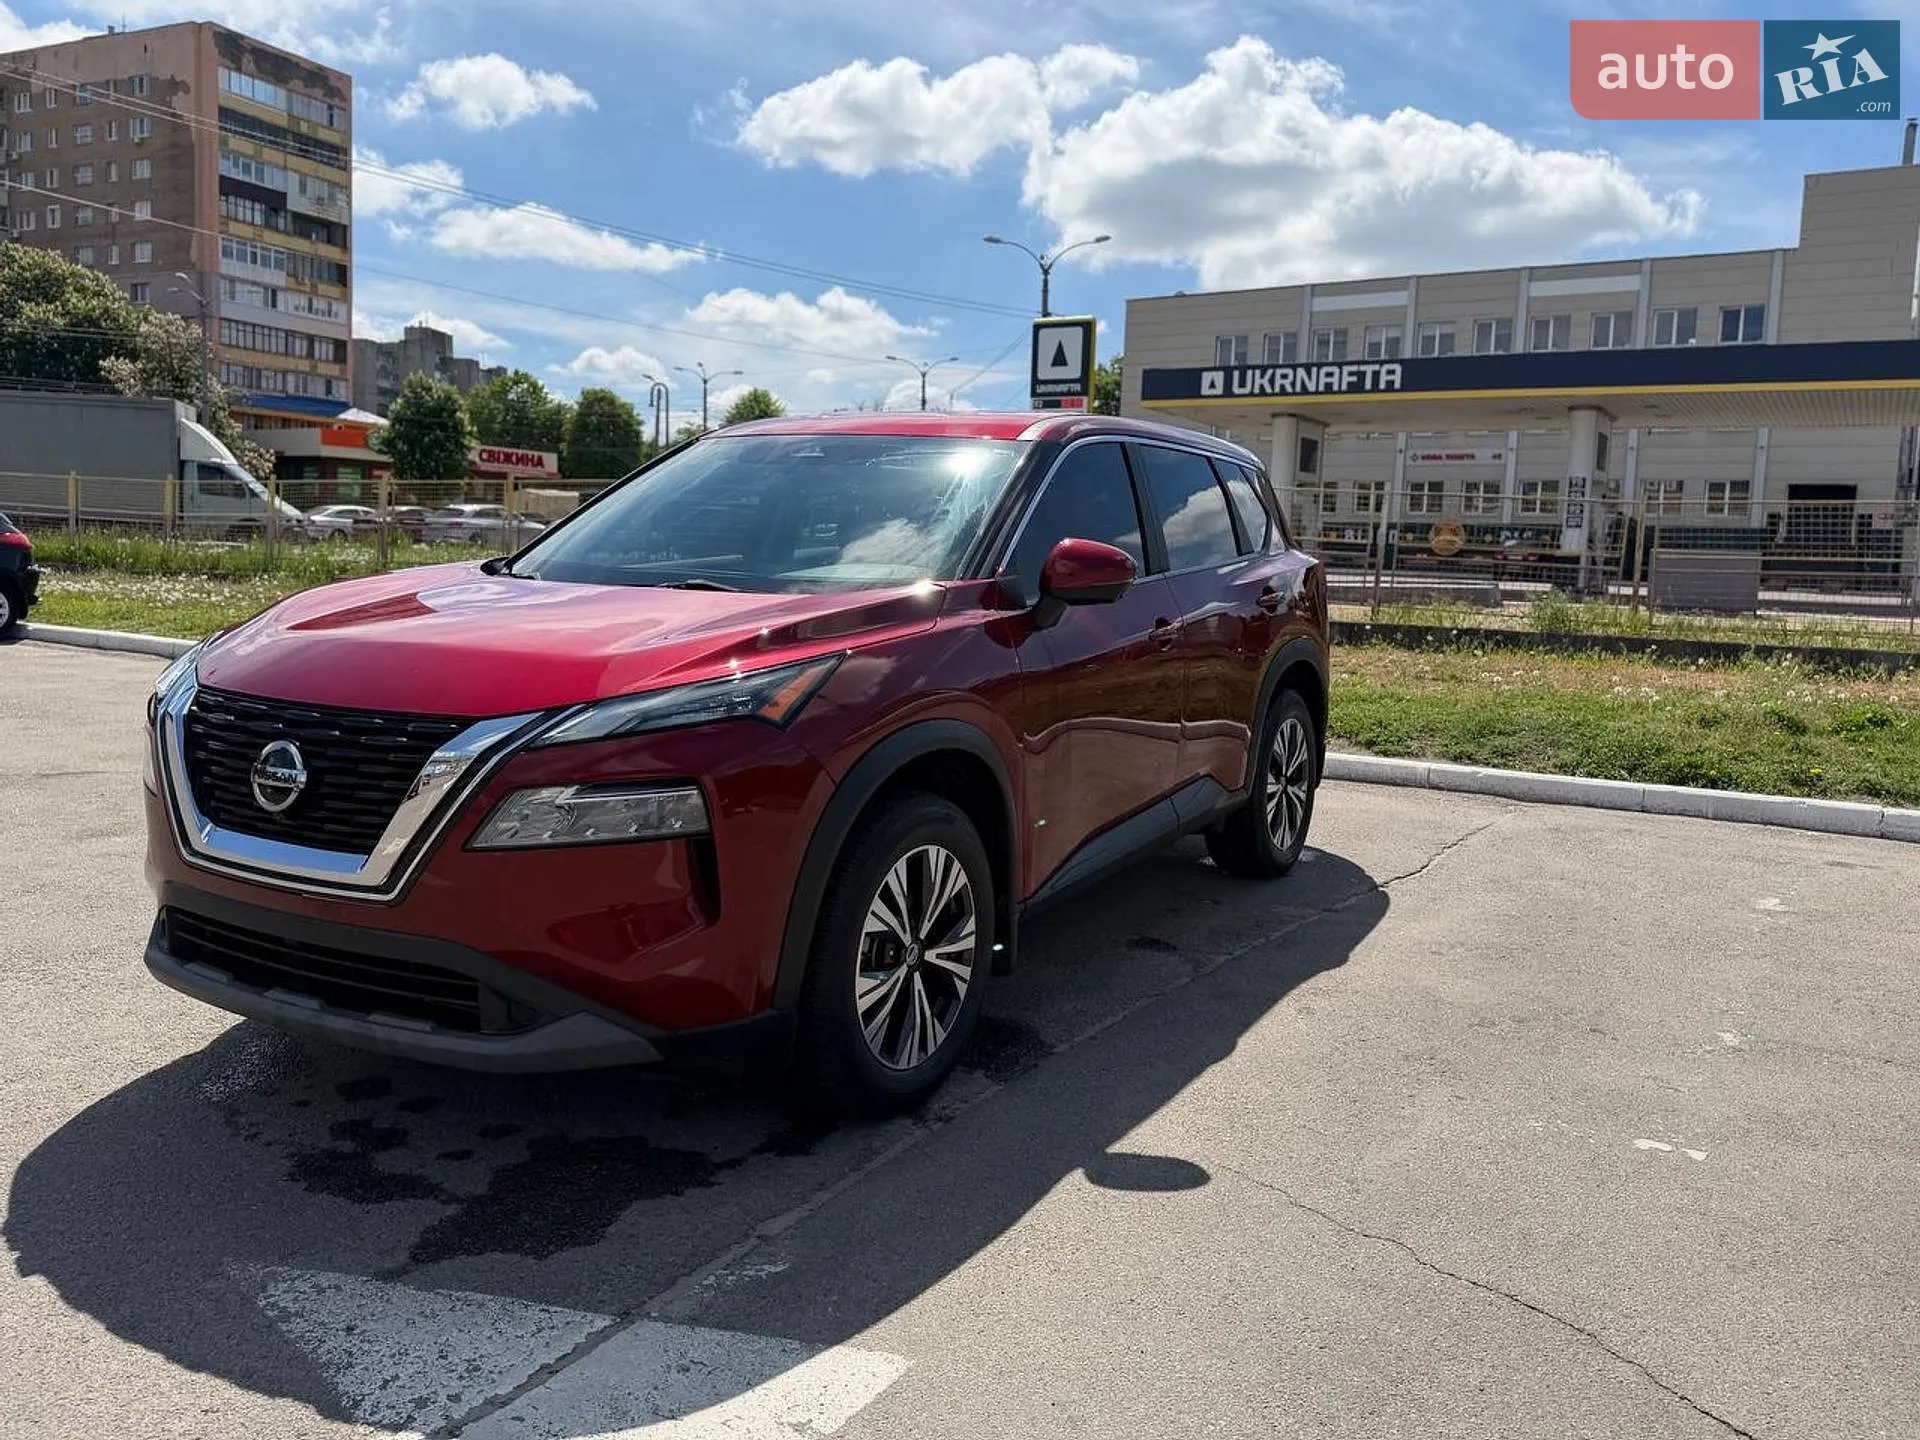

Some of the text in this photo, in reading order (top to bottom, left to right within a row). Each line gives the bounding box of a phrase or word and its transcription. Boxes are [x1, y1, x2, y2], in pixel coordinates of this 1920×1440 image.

[1231, 363, 1402, 395] UKRNAFTA
[478, 448, 545, 469] СВІЖИНА
[252, 768, 298, 785] NISSAN
